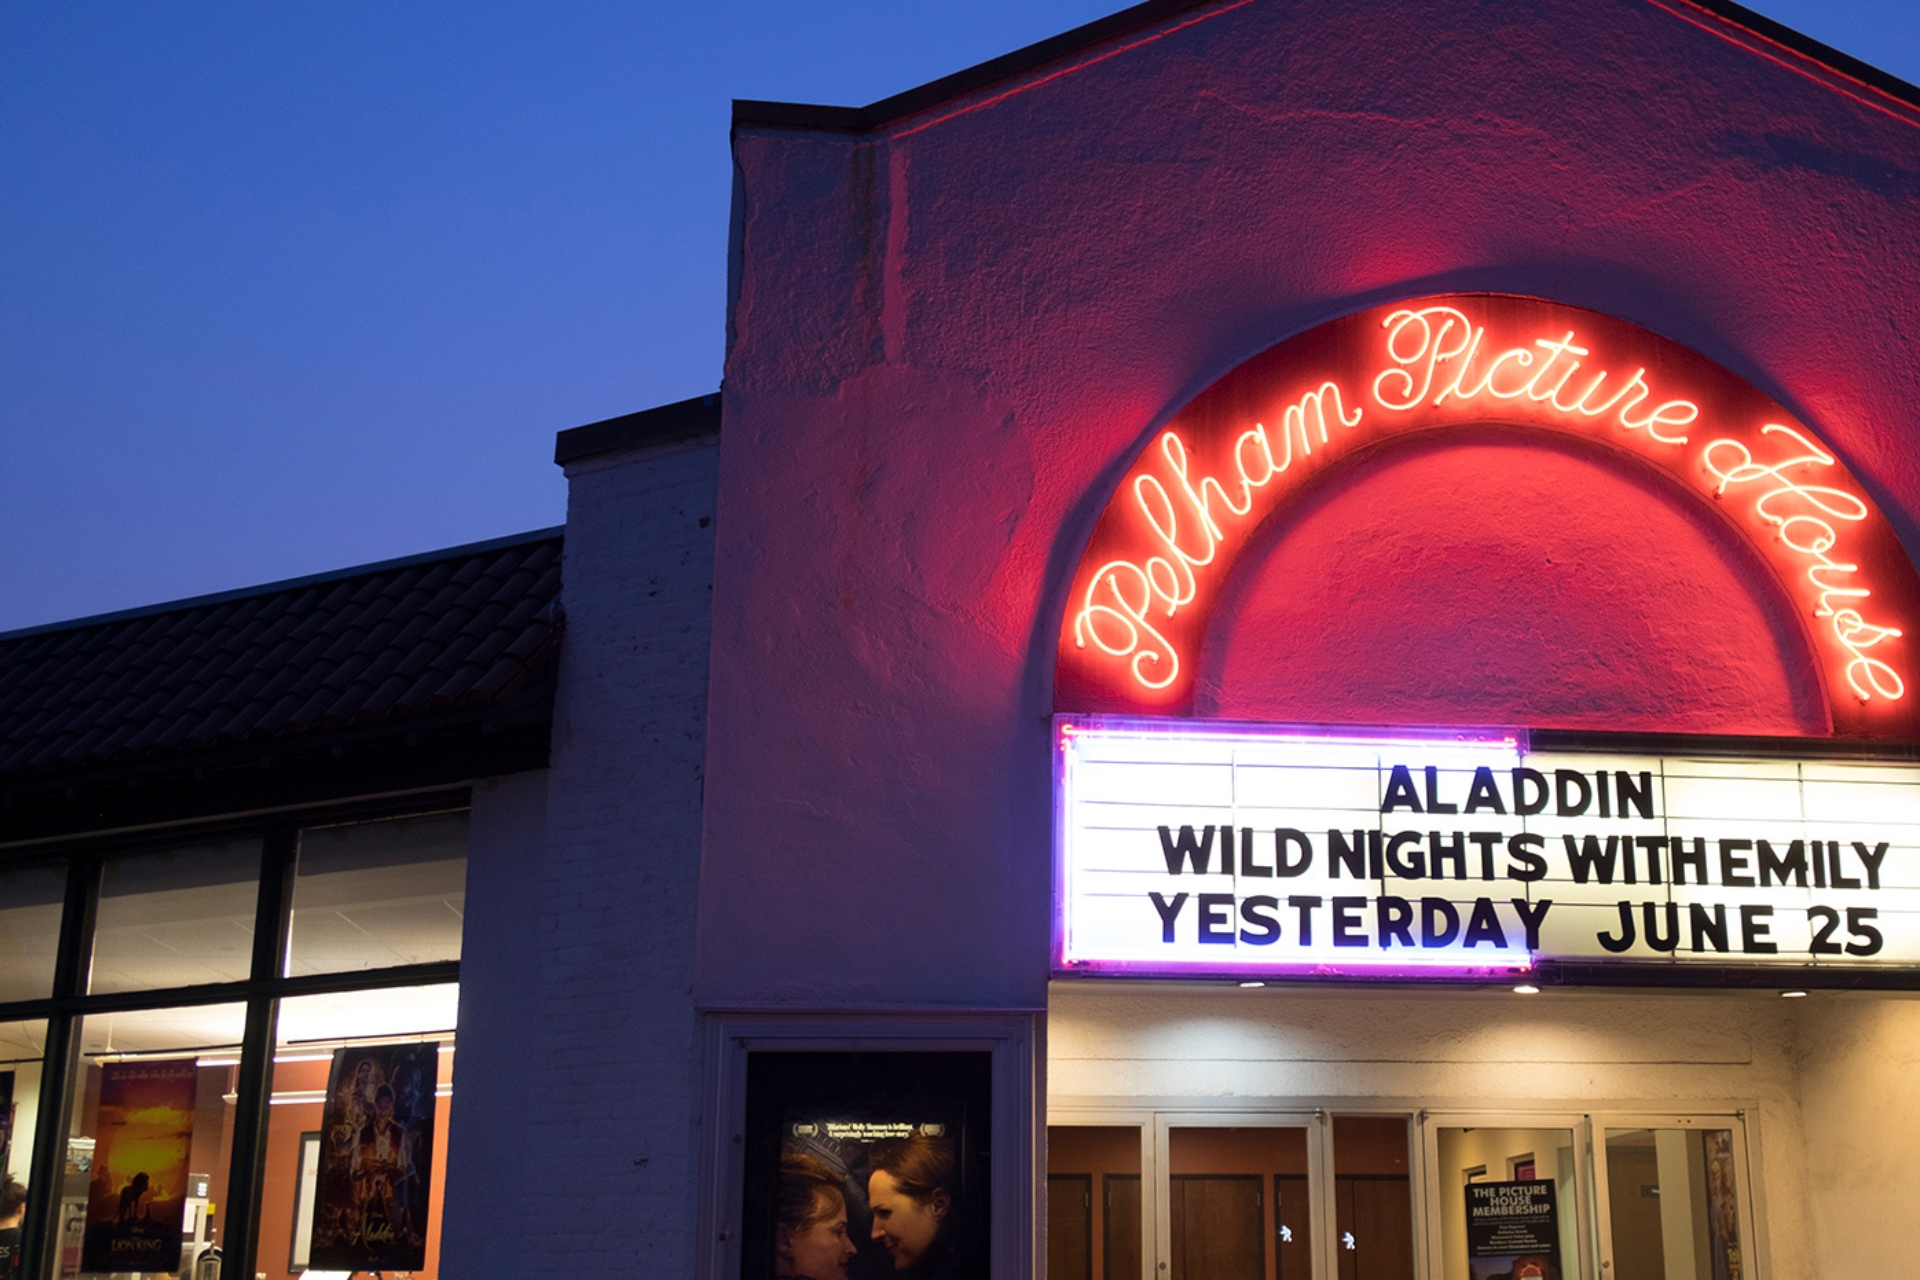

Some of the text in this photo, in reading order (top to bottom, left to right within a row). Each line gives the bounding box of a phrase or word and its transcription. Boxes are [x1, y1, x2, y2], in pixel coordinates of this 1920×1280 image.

[1075, 307, 1904, 704] Pelham Picture House
[1380, 764, 1654, 819] ALADDIN
[1157, 825, 1890, 889] WILD NIGHTS WITH EMILY
[1148, 892, 1883, 956] YESTERDAY JUNE 25
[1473, 1185, 1548, 1198] THE PICTURE
[1490, 1196, 1532, 1207] HOUSE
[1473, 1204, 1551, 1217] MEMBERSHIP
[110, 1238, 162, 1252] LION KING
